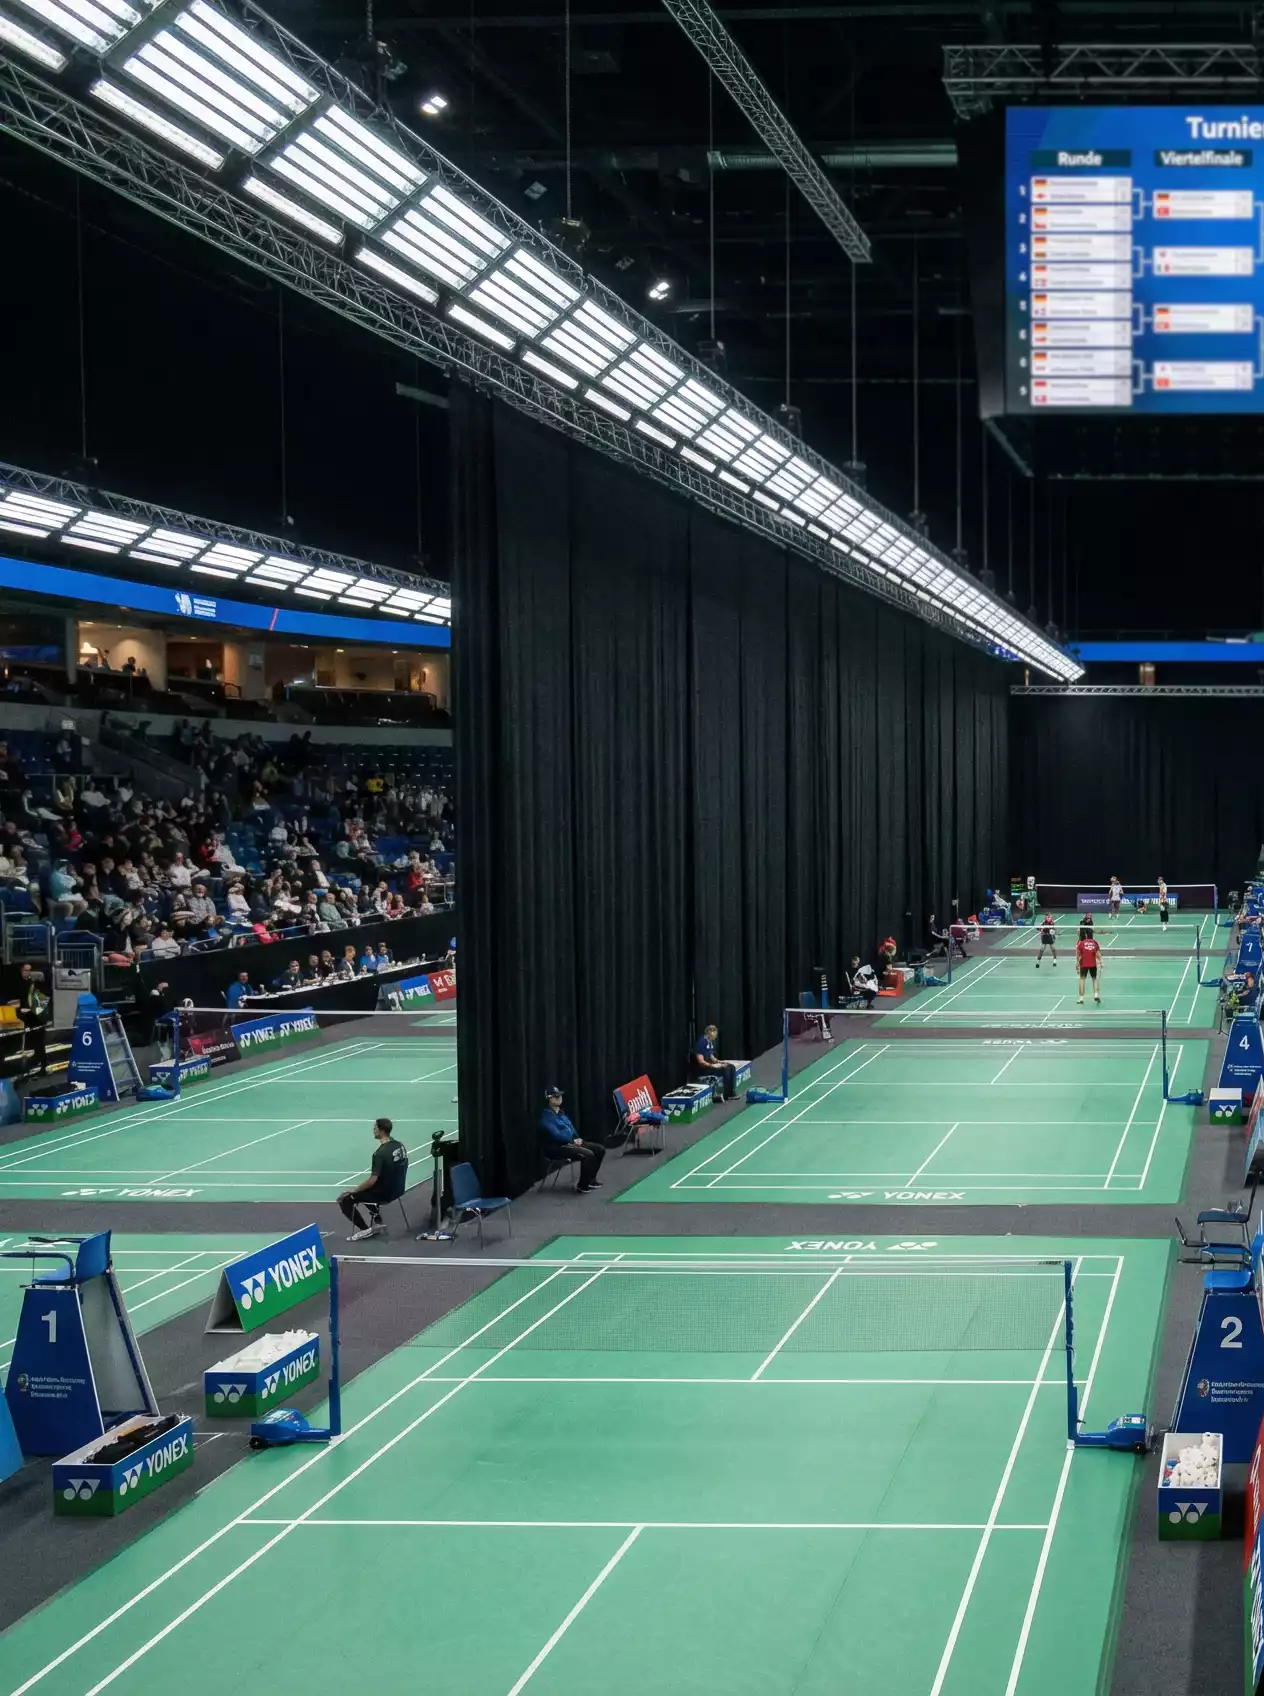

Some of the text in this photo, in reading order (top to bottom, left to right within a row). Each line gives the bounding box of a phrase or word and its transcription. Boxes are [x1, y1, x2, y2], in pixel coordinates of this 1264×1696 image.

[1058, 151, 1103, 166] Runde
[1160, 150, 1244, 166] Viertelfinale
[82, 1031, 93, 1046] 6
[1238, 1034, 1251, 1051] 4
[883, 1191, 967, 1200] YONEX
[784, 1240, 878, 1250] YONEX
[267, 1244, 324, 1293] YONEX
[41, 1310, 57, 1343] 1
[1220, 1316, 1244, 1349] 2
[282, 1349, 316, 1386] YONEX
[145, 1433, 189, 1477] YONEX
